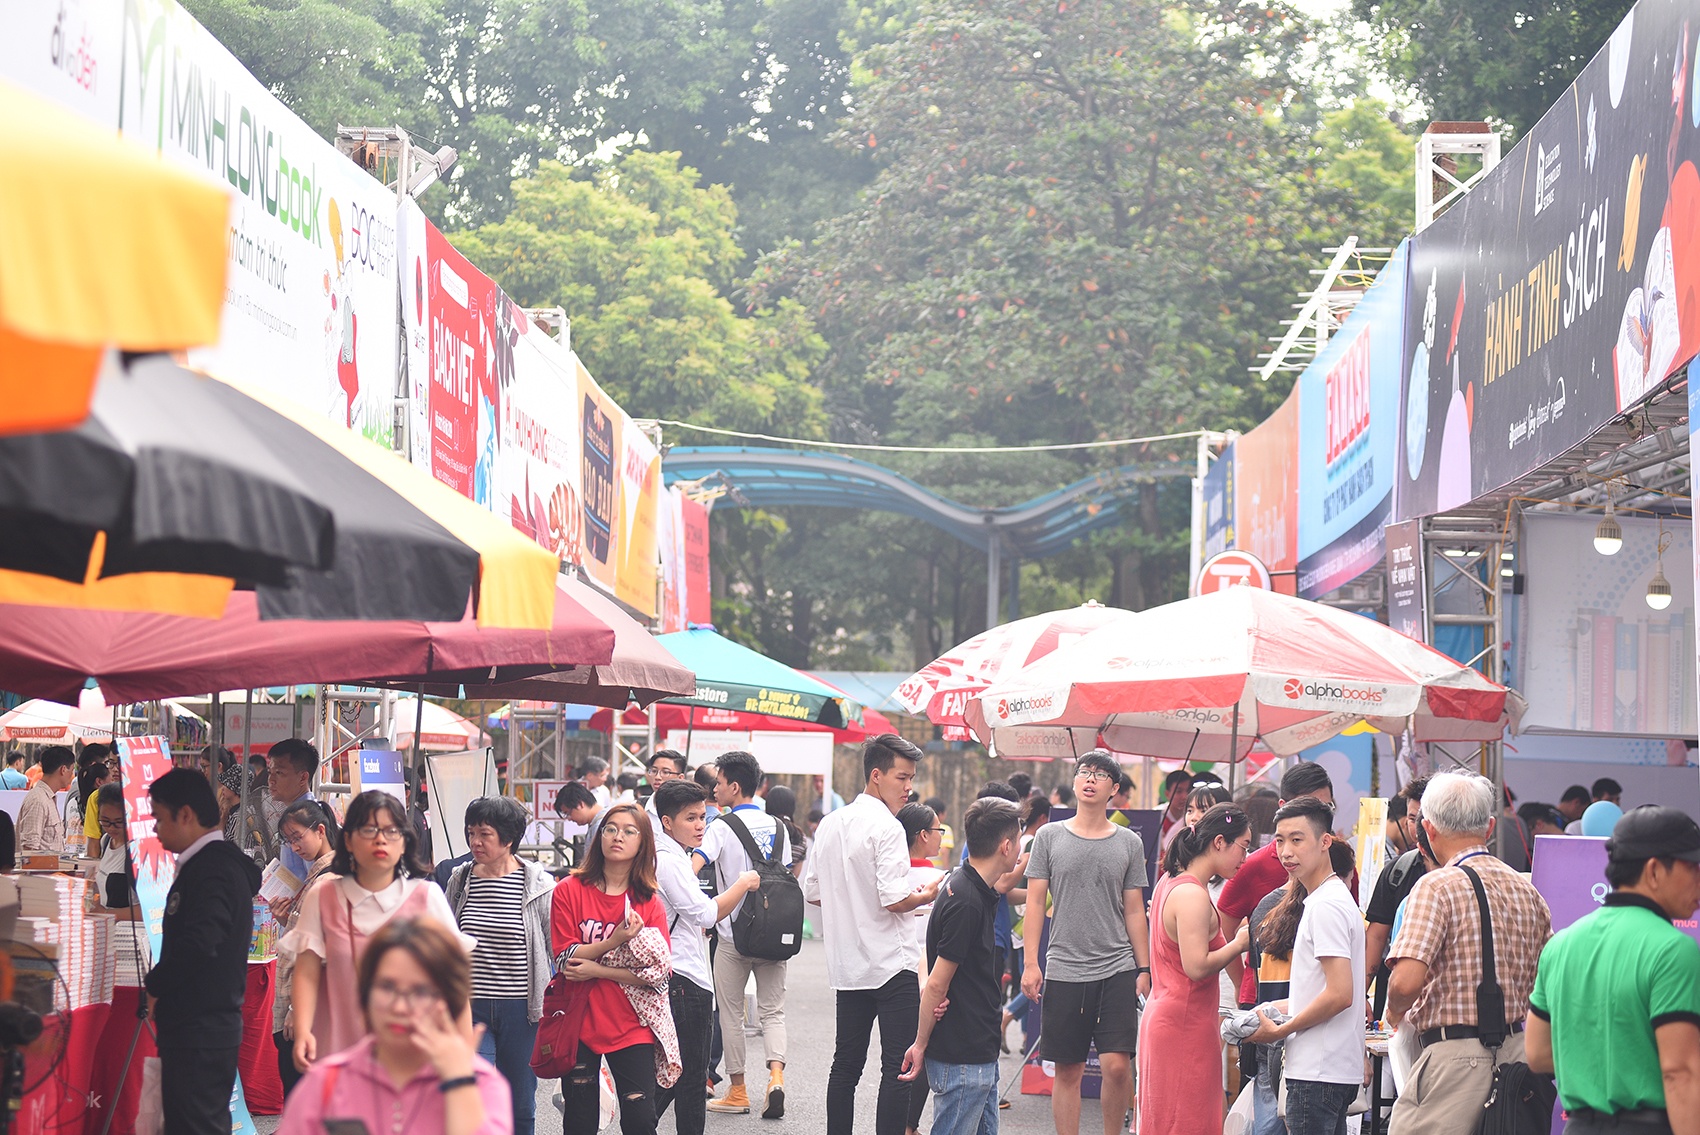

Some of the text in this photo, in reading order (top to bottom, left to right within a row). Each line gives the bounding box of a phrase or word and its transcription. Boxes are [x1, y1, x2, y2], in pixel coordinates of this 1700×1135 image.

[1484, 273, 1524, 386] HÀNH
[1563, 197, 1609, 329] SÁCH
[1305, 682, 1383, 702] alphabooks
[1009, 693, 1053, 713] alphabooks
[1673, 919, 1698, 928] mua
